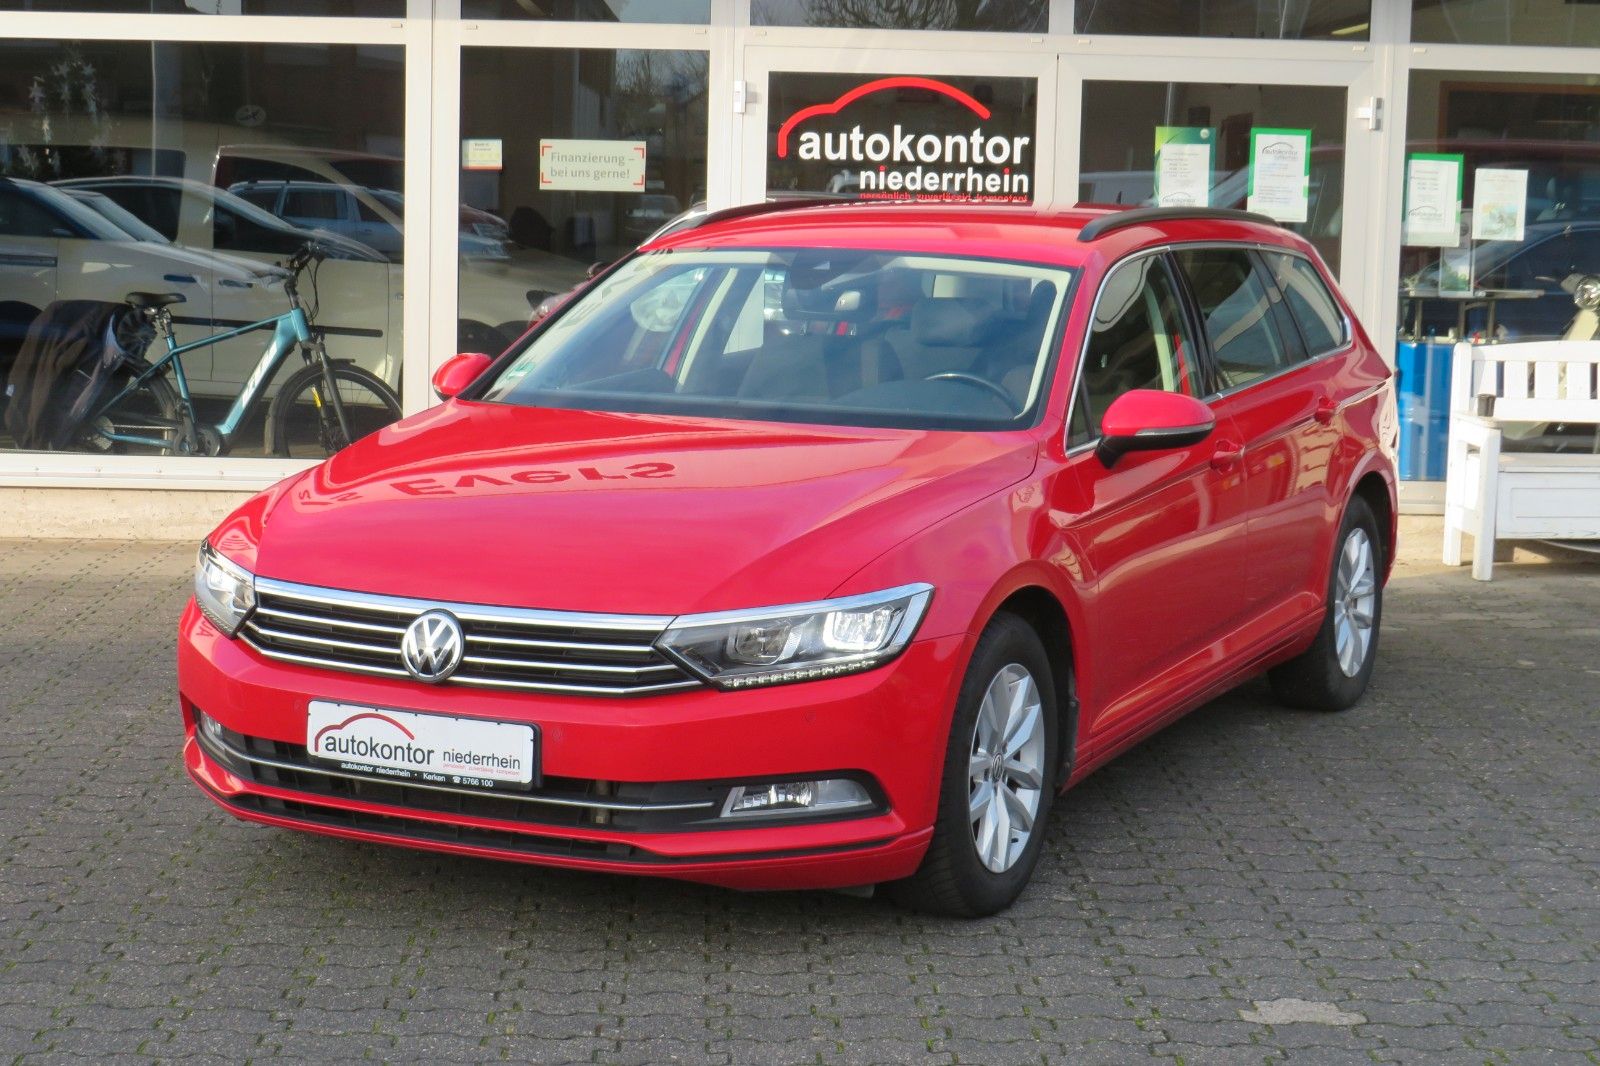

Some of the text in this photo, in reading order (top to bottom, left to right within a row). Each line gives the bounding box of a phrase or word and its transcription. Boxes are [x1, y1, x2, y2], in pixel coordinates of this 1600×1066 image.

[798, 124, 1029, 164] autokontor
[550, 152, 625, 165] Finanzierung
[550, 166, 630, 180] bei uns gerne!
[860, 165, 1029, 192] niederrhein
[325, 735, 435, 765] autokontor
[443, 748, 521, 770] niederrhein
[341, 762, 373, 772] autokontor
[376, 766, 411, 778] niederrhein
[423, 772, 446, 782] Kerken
[481, 779, 494, 787] 100
